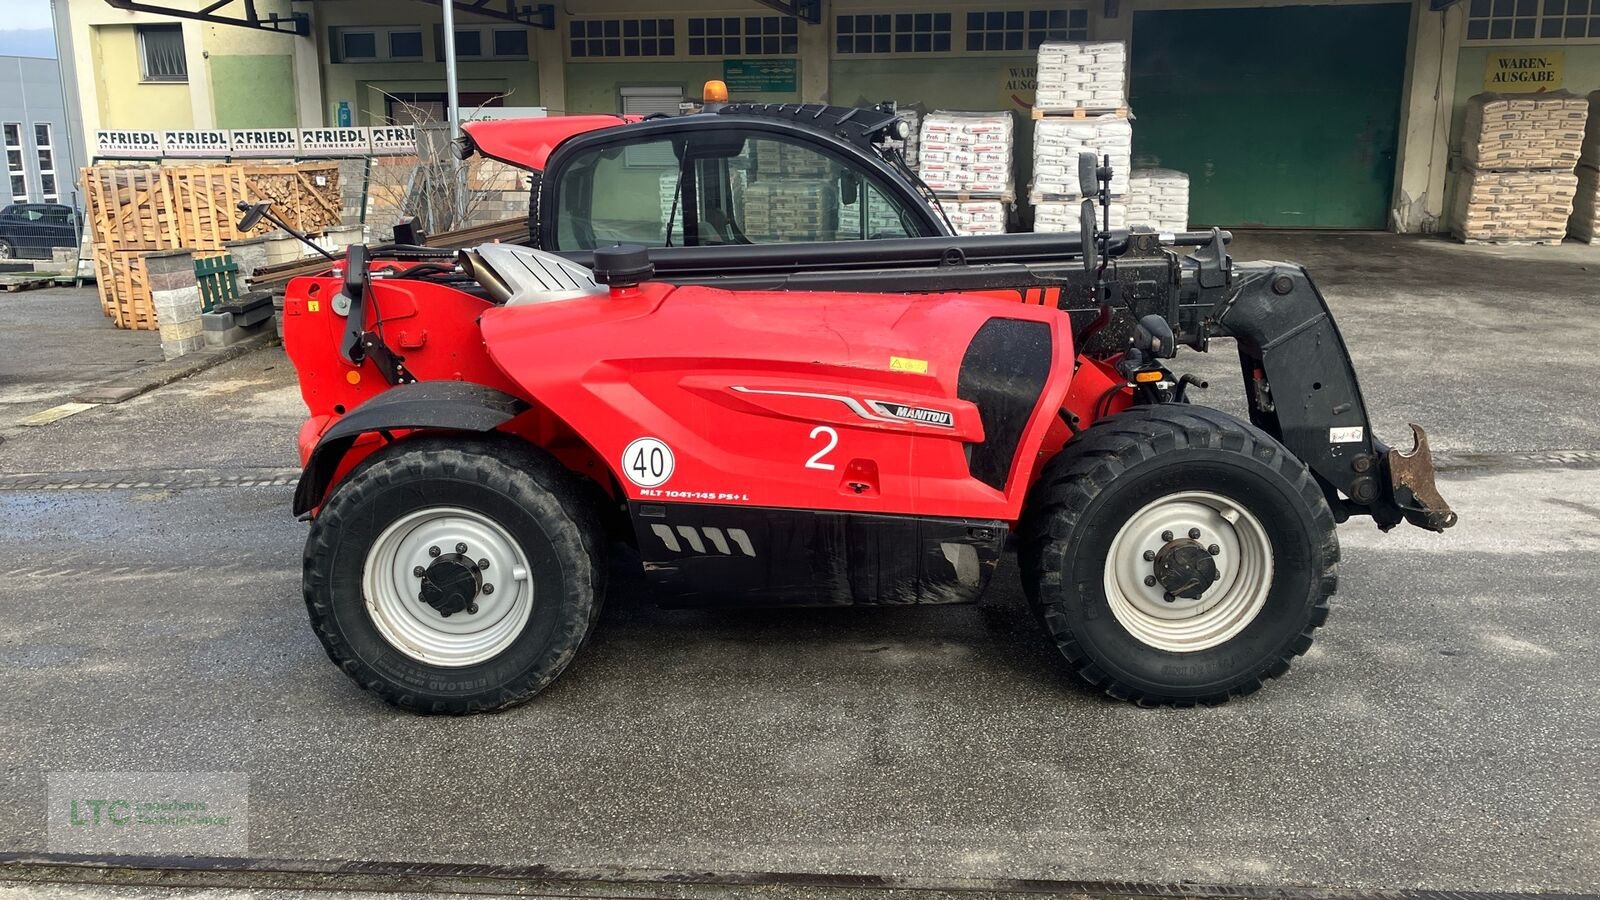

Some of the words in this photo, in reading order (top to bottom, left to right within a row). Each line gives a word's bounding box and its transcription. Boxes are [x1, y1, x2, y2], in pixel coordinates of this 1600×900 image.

[1498, 58, 1552, 69] WAREN-
[1009, 68, 1038, 78] WAR
[1493, 71, 1555, 82] AUSGABE
[110, 132, 159, 144] FRIEDL
[178, 132, 227, 144] FRIEDL
[247, 131, 295, 143] FRIEDL
[315, 130, 366, 142] FRIEDL
[896, 406, 948, 423] MANITOU
[804, 425, 839, 471] 2
[633, 447, 664, 478] 40
[640, 489, 663, 497] MLT
[665, 490, 716, 499] 1041-145
